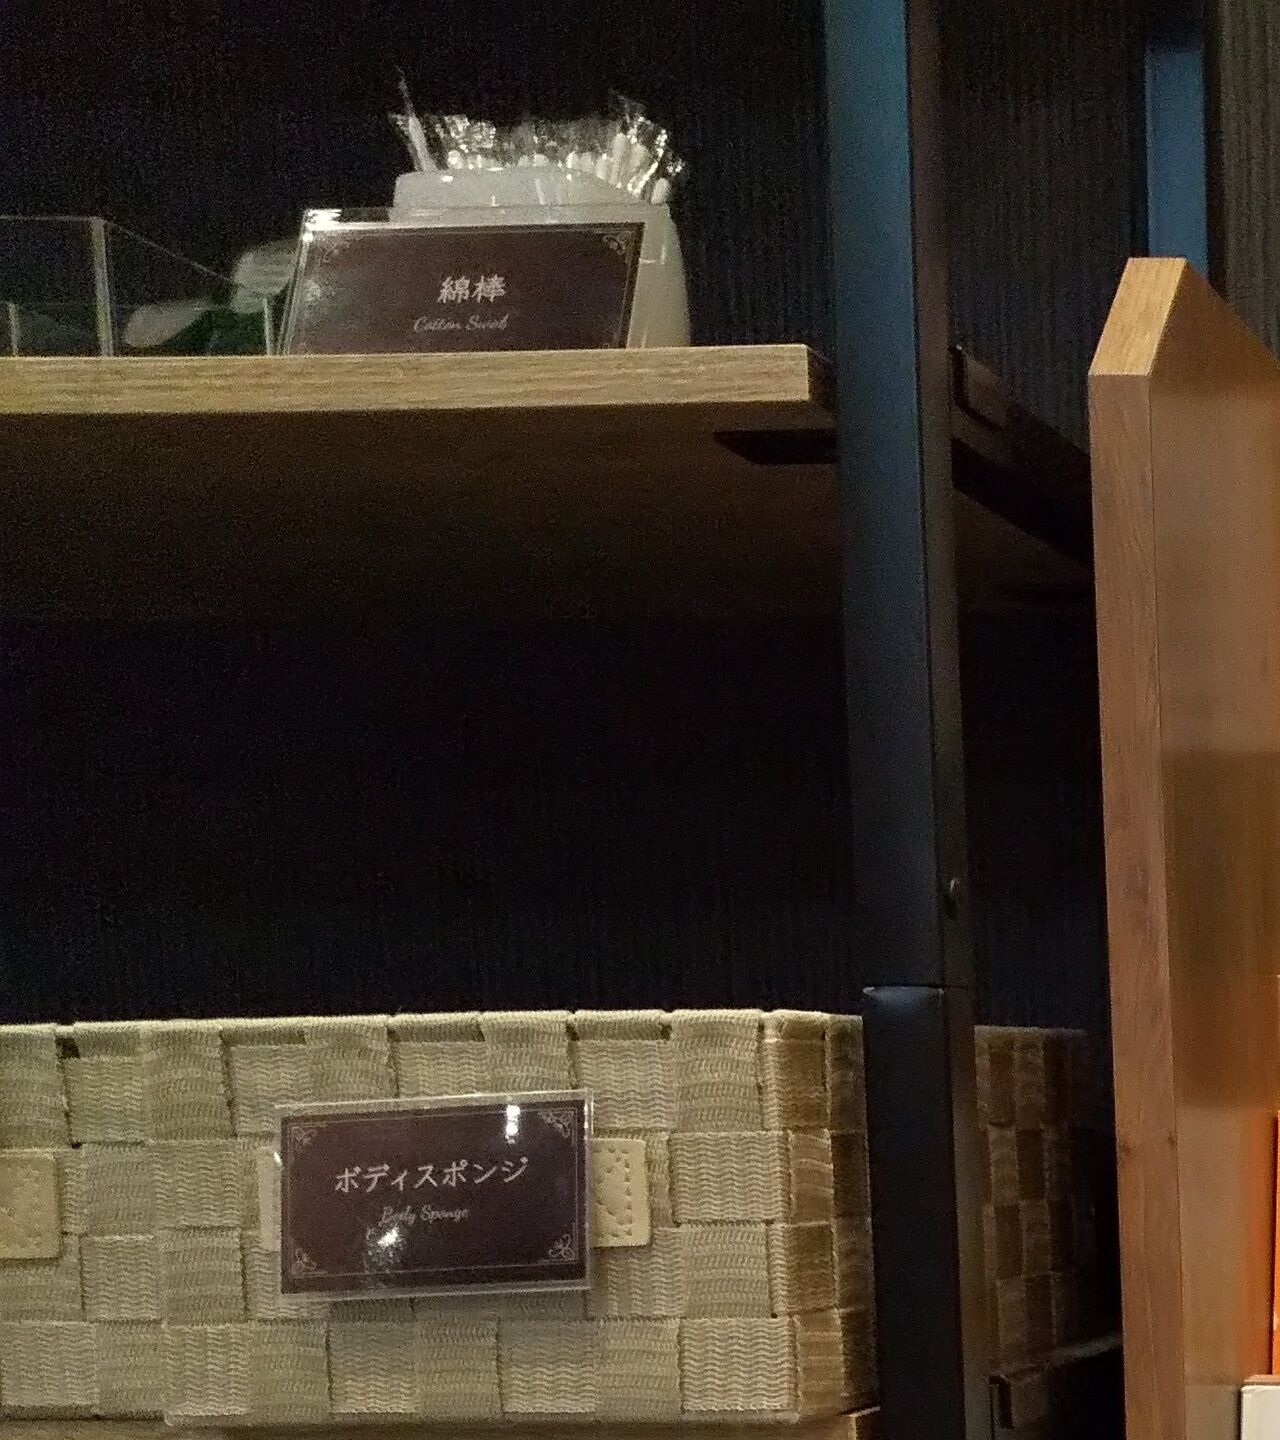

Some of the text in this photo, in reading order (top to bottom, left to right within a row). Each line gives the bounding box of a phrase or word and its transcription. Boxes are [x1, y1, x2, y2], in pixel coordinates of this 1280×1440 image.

[437, 275, 506, 304] 綿棒
[334, 1156, 529, 1193] ボディスポンジ
